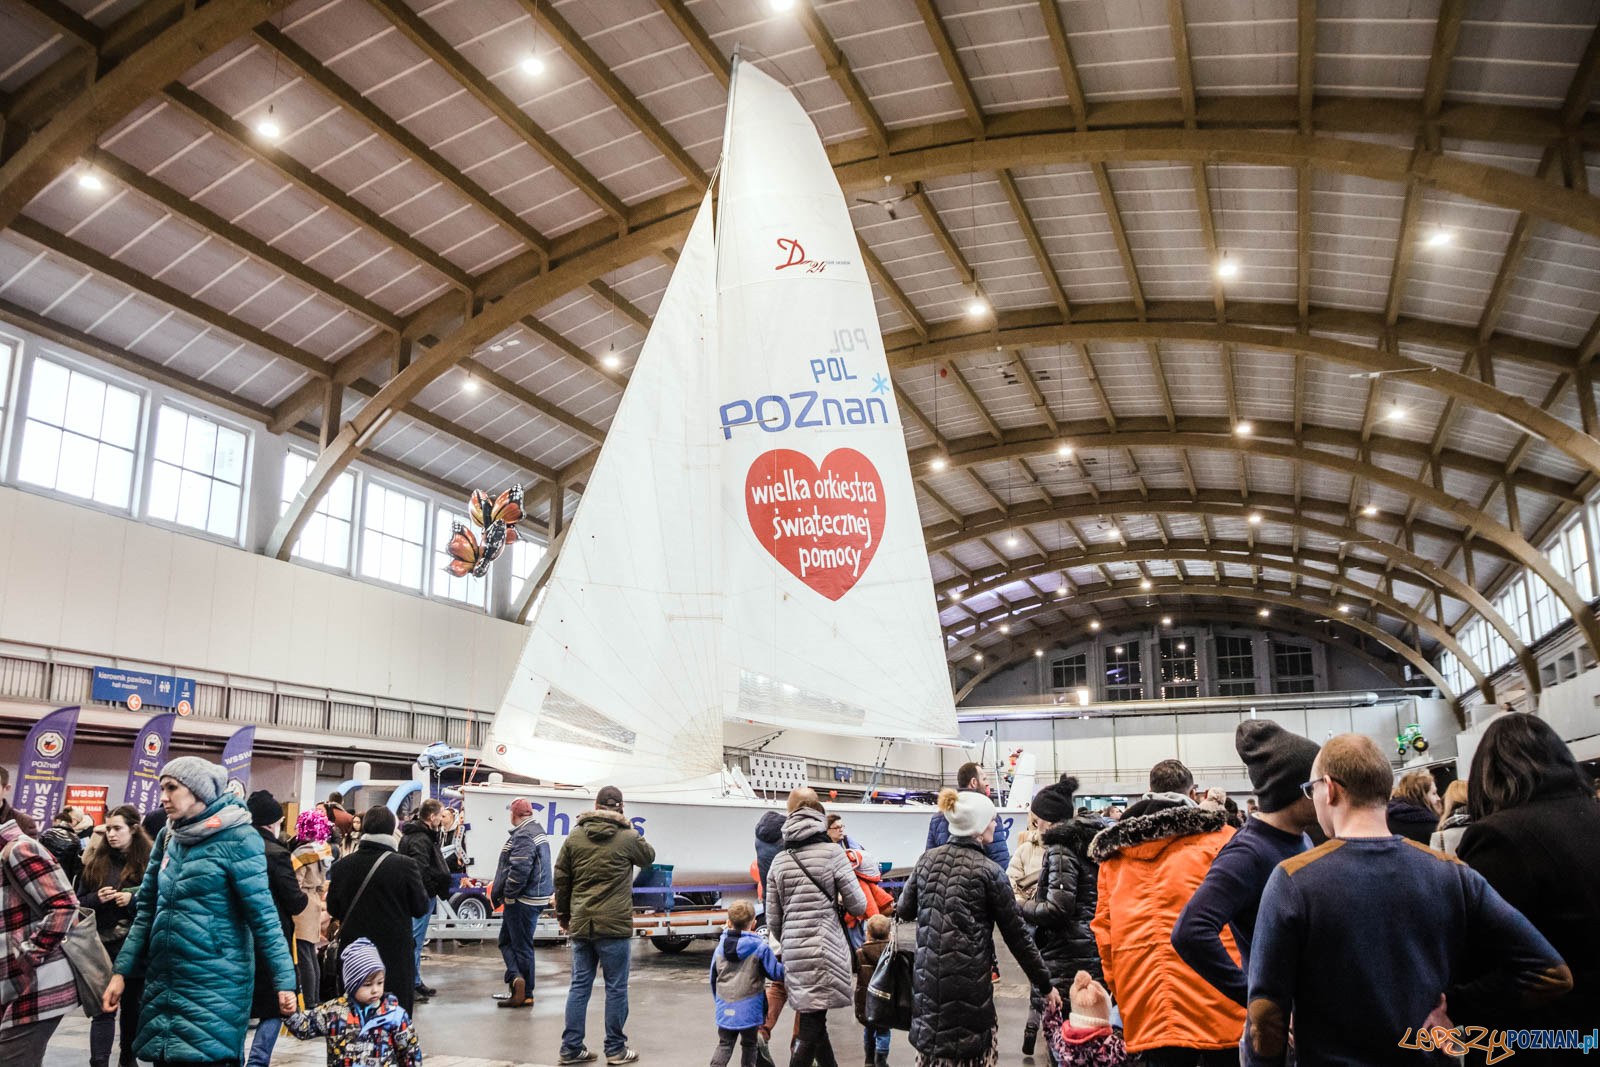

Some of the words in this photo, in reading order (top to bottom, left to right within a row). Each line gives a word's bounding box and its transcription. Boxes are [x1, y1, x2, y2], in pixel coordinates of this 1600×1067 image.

[810, 357, 857, 383] POL
[752, 468, 811, 504] wielka
[814, 470, 877, 502] orkiestra
[772, 505, 872, 549] świątecznej
[799, 546, 862, 577] pomocy
[71, 789, 104, 798] WSSW
